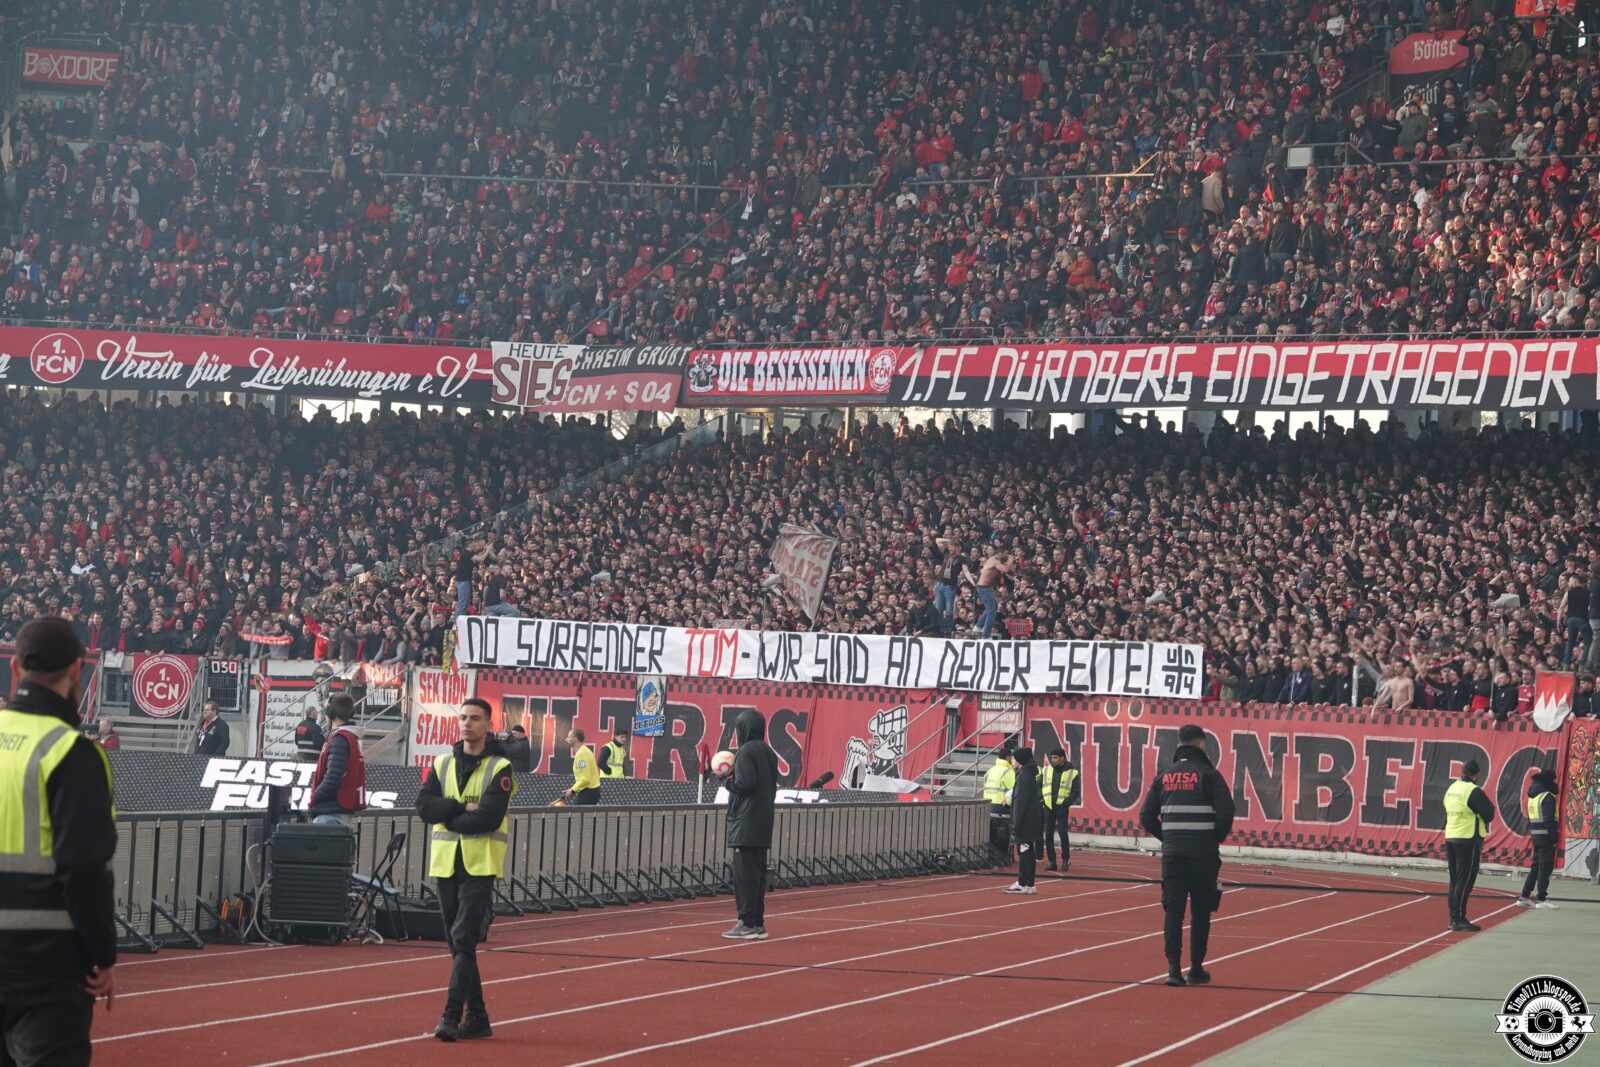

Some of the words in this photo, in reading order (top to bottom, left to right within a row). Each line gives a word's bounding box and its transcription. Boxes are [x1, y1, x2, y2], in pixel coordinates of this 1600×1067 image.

[22, 51, 118, 81] BOXDORF
[36, 354, 77, 374] FCN
[509, 343, 568, 359] HEUTE
[97, 335, 182, 382] Verein
[186, 356, 232, 389] für
[240, 346, 411, 398] Leibesübungen
[492, 356, 573, 406] SIEG
[718, 351, 753, 392] DIE
[752, 349, 871, 392] BESESSENEN
[874, 366, 890, 379] FCN
[984, 345, 1196, 404] NÜRNBERG
[1206, 341, 1578, 408] EINGETRAGENER
[467, 616, 499, 665] NO
[517, 618, 667, 674] SURRENDER
[760, 632, 802, 682] WIR
[814, 633, 869, 685] SIND
[884, 636, 924, 688] AN
[936, 639, 1031, 692] DEINER
[1049, 640, 1154, 695] SEITE!
[145, 681, 179, 701] FCN
[419, 671, 469, 705] SEKTION
[0, 733, 28, 751] HEIT
[200, 757, 319, 788] FAST
[1162, 772, 1198, 784] AVISA
